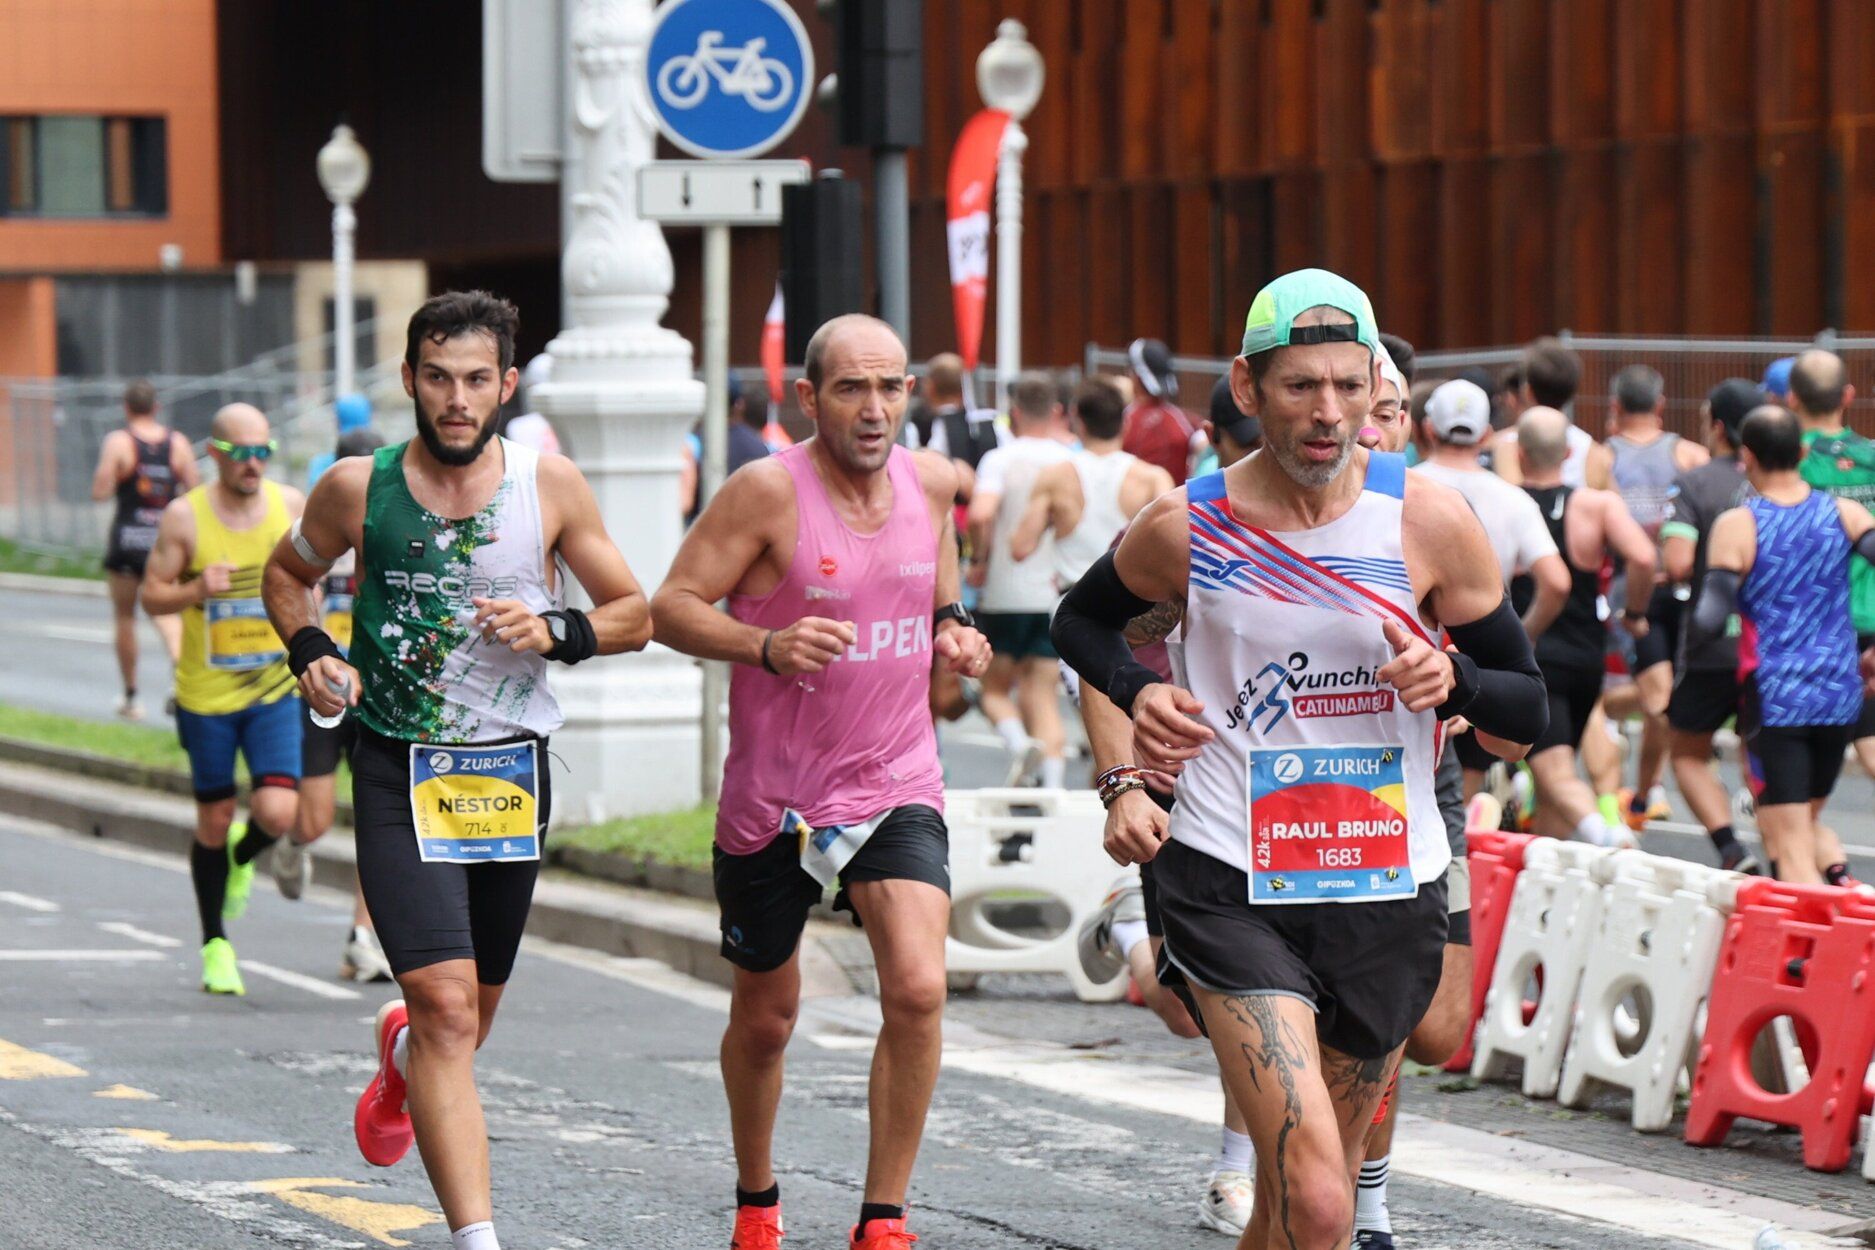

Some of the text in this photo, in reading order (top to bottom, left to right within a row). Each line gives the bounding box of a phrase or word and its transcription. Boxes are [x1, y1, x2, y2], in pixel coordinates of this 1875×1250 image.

[460, 754, 517, 771] ZURICH
[1313, 758, 1380, 776] ZURICH
[438, 793, 523, 814] NÉSTOR
[465, 822, 492, 836] 714
[1272, 822, 1333, 840] RAUL
[1338, 819, 1404, 839] BRUNO
[1316, 848, 1362, 867] 1683
